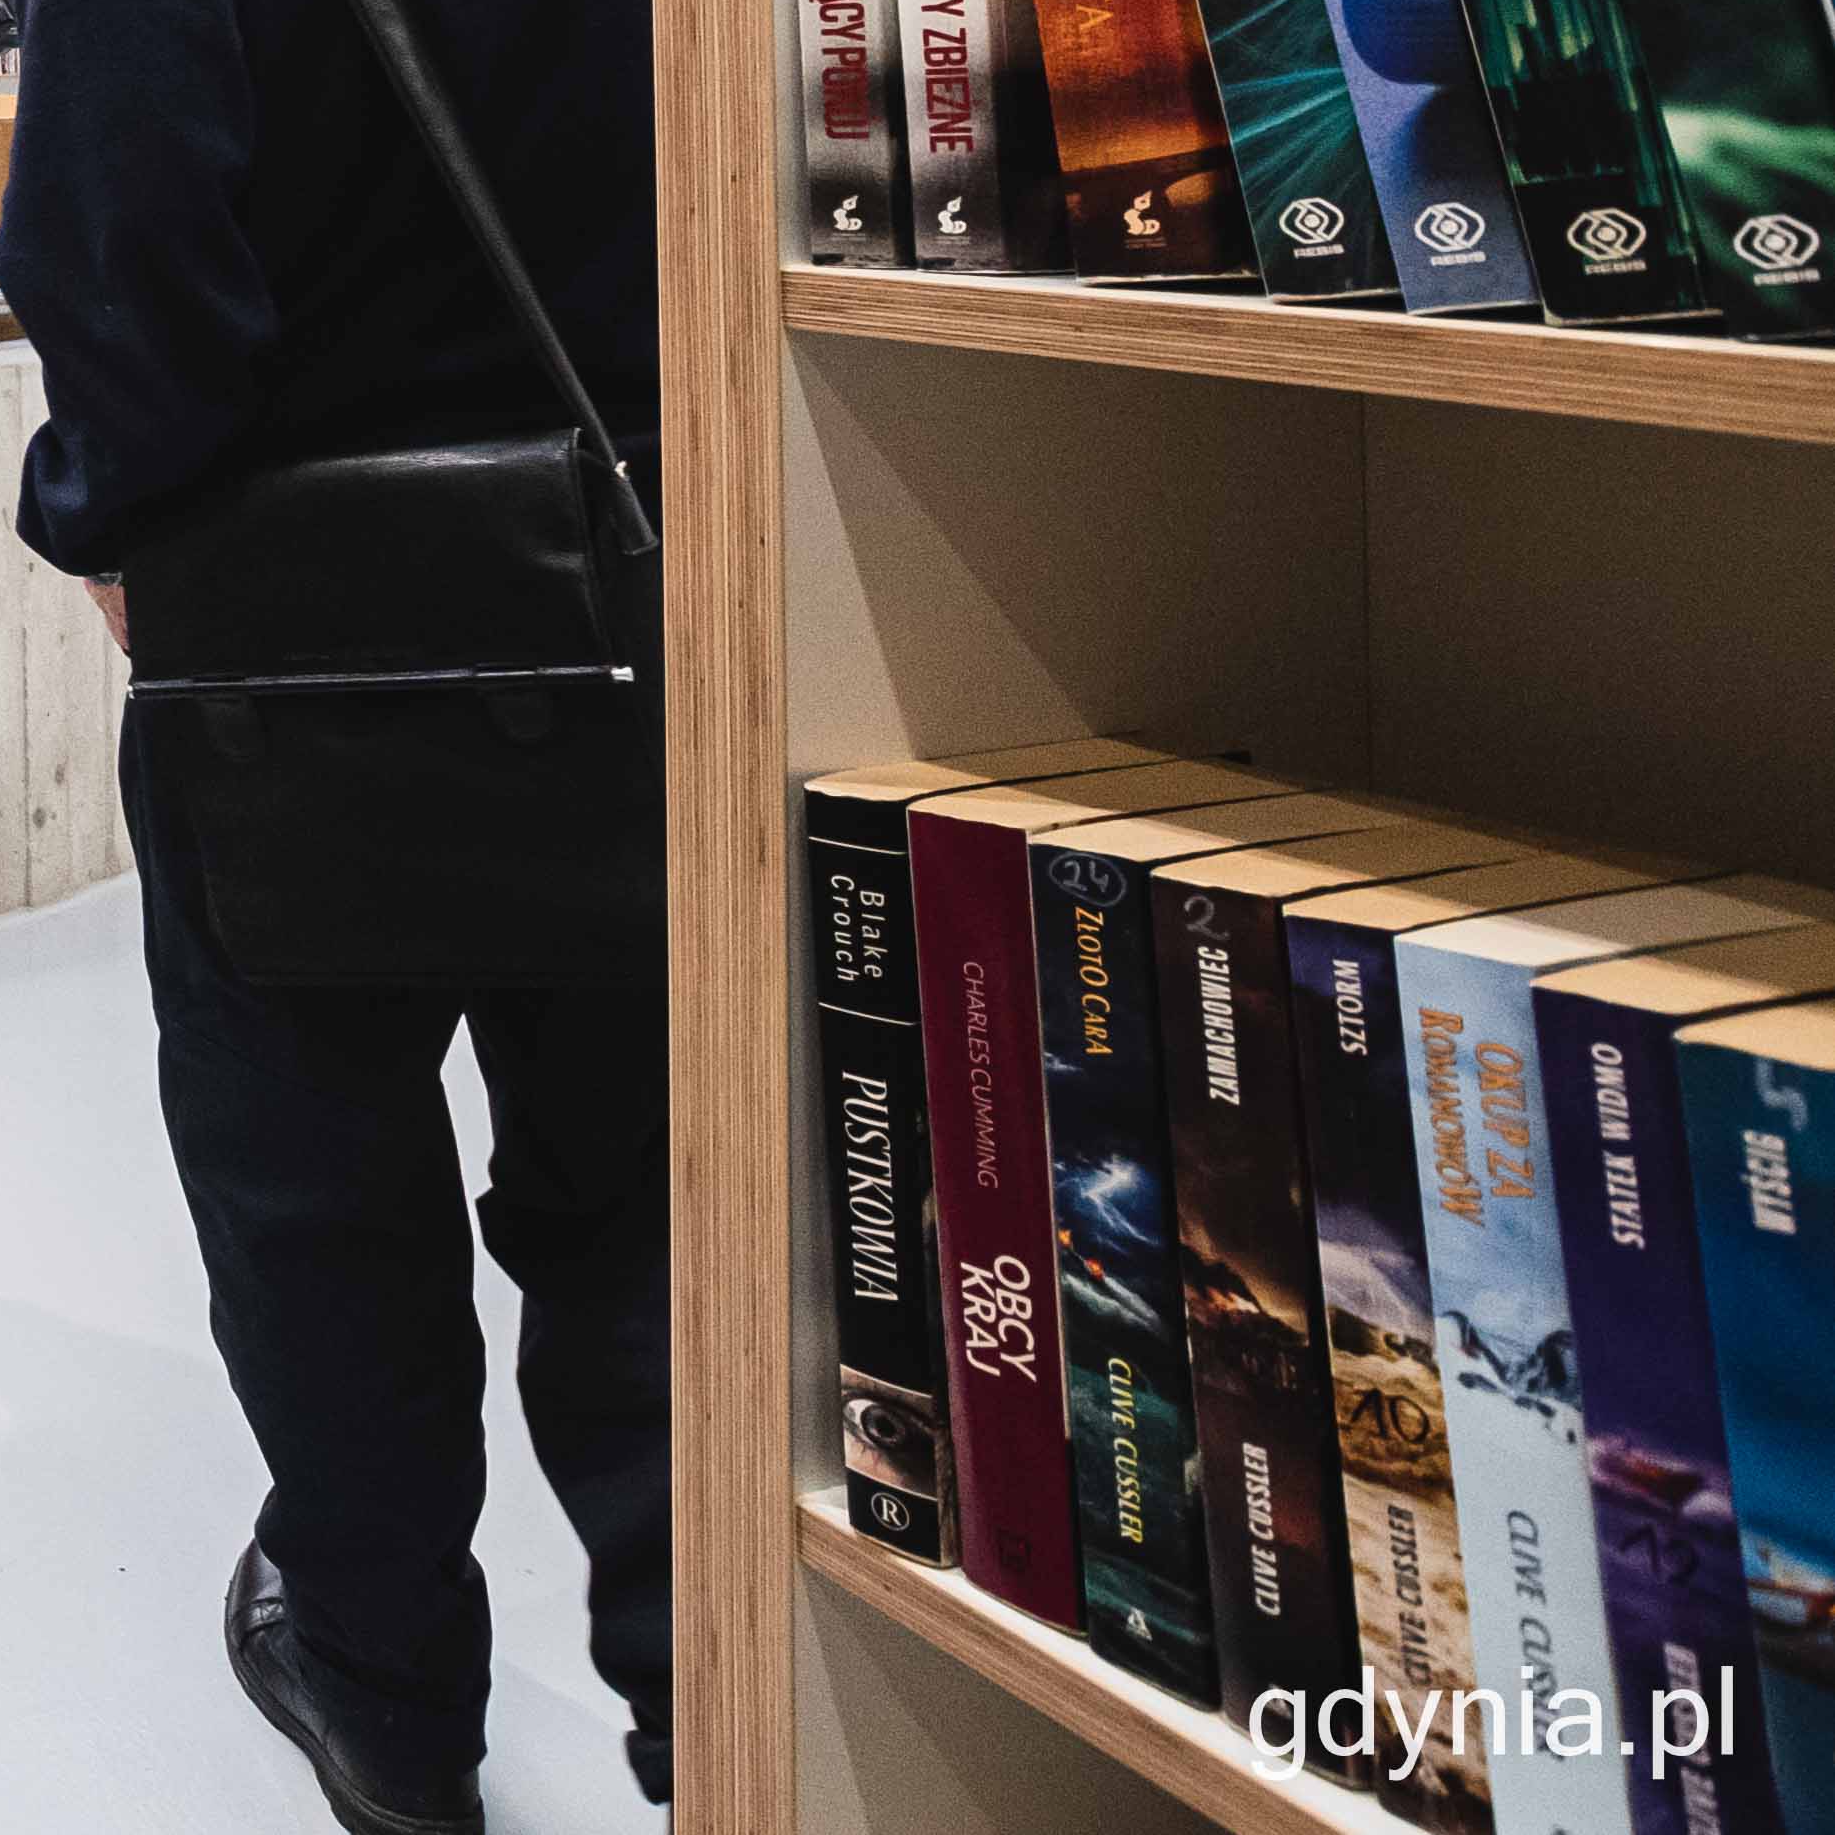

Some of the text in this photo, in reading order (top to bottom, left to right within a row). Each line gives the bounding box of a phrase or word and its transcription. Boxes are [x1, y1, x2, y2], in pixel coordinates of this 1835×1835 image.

[922, 27, 980, 154] ZBIEŻNE
[827, 873, 859, 983] Crouch
[857, 889, 889, 979] Blake
[1073, 905, 1114, 1056] ZŁOTO CARA
[960, 960, 999, 1189] CHARLES CUMMING
[1196, 945, 1242, 1106] ZAMACHOWIEC
[1331, 957, 1369, 1056] SZTORM
[840, 1070, 899, 1305] PUSTKOWIA
[1418, 1005, 1486, 1230] ROMANOWÓW
[1472, 1041, 1535, 1201] OKUP ZA
[1589, 1041, 1647, 1251] STATEK WIDMO
[959, 1260, 1002, 1377] KRAJ
[992, 1253, 1038, 1384] OBCY
[1105, 1356, 1145, 1543] CLIVE CUSSLER
[1242, 1441, 1282, 1617] CLIVE CUSSLER
[1504, 1508, 1544, 1608] CLIVE
